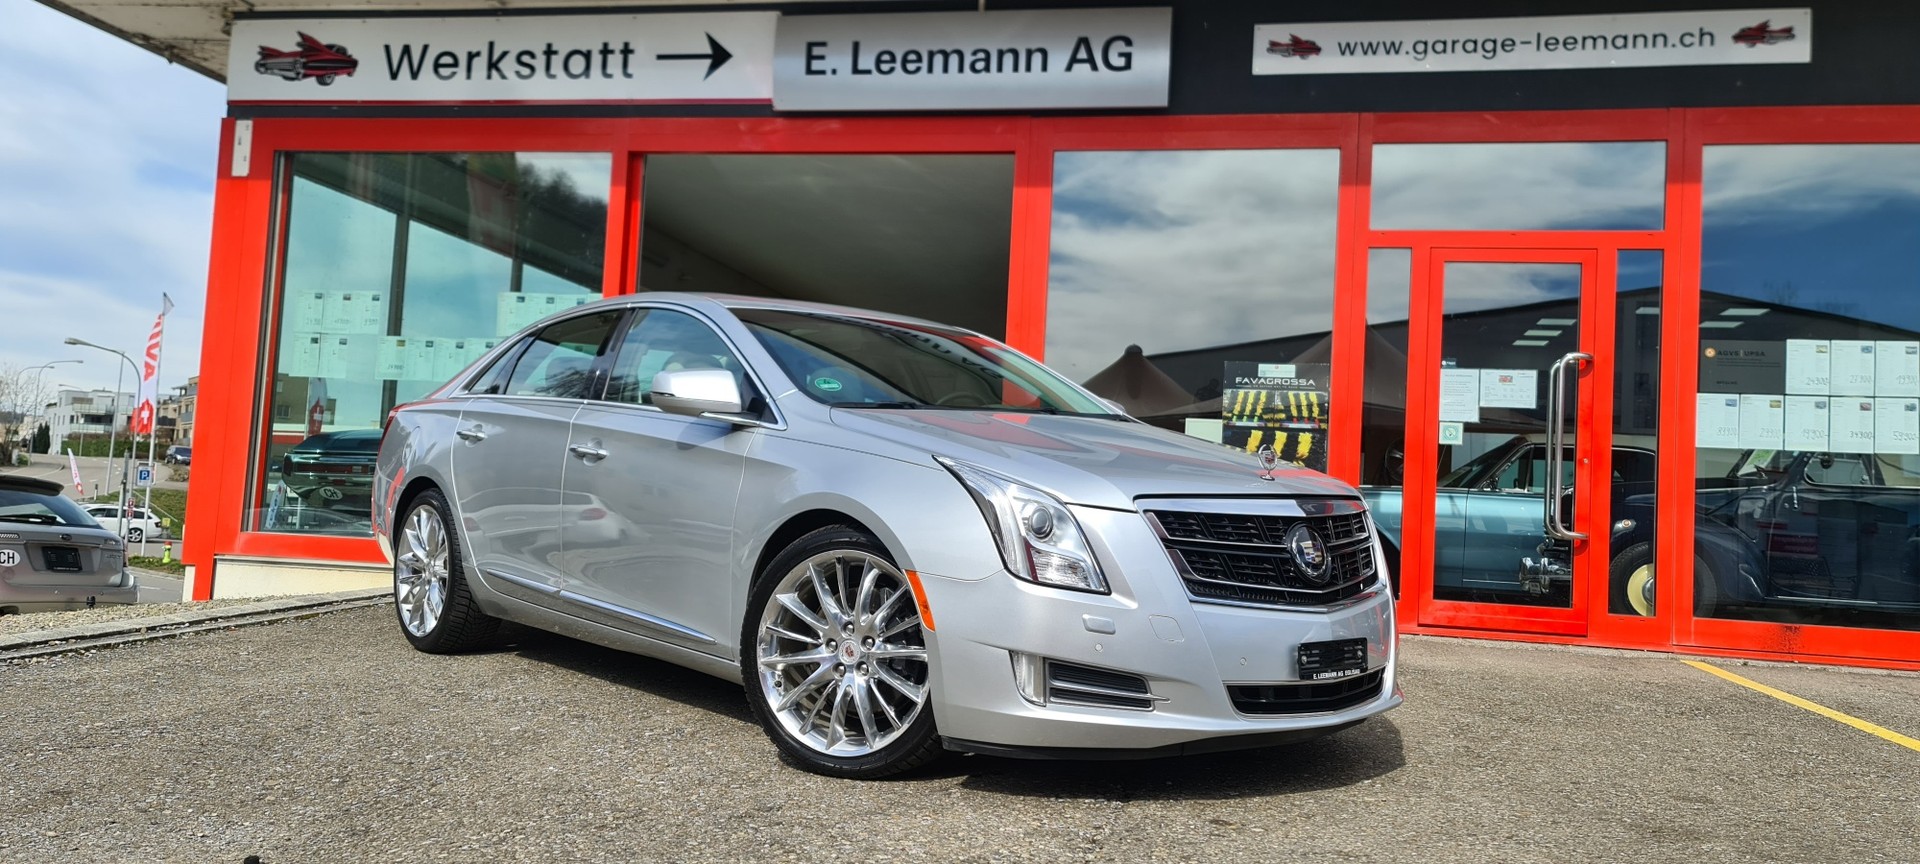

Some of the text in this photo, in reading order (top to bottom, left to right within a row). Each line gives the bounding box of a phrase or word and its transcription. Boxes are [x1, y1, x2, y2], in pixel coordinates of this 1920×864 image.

[804, 35, 1134, 75] E. Leemann AG
[1337, 27, 1716, 61] www.garage-leemann.ch
[384, 41, 634, 82] Werkstatt
[1235, 376, 1316, 386] FAVAGROSSA
[324, 488, 339, 499] CH
[0, 551, 15, 564] CH
